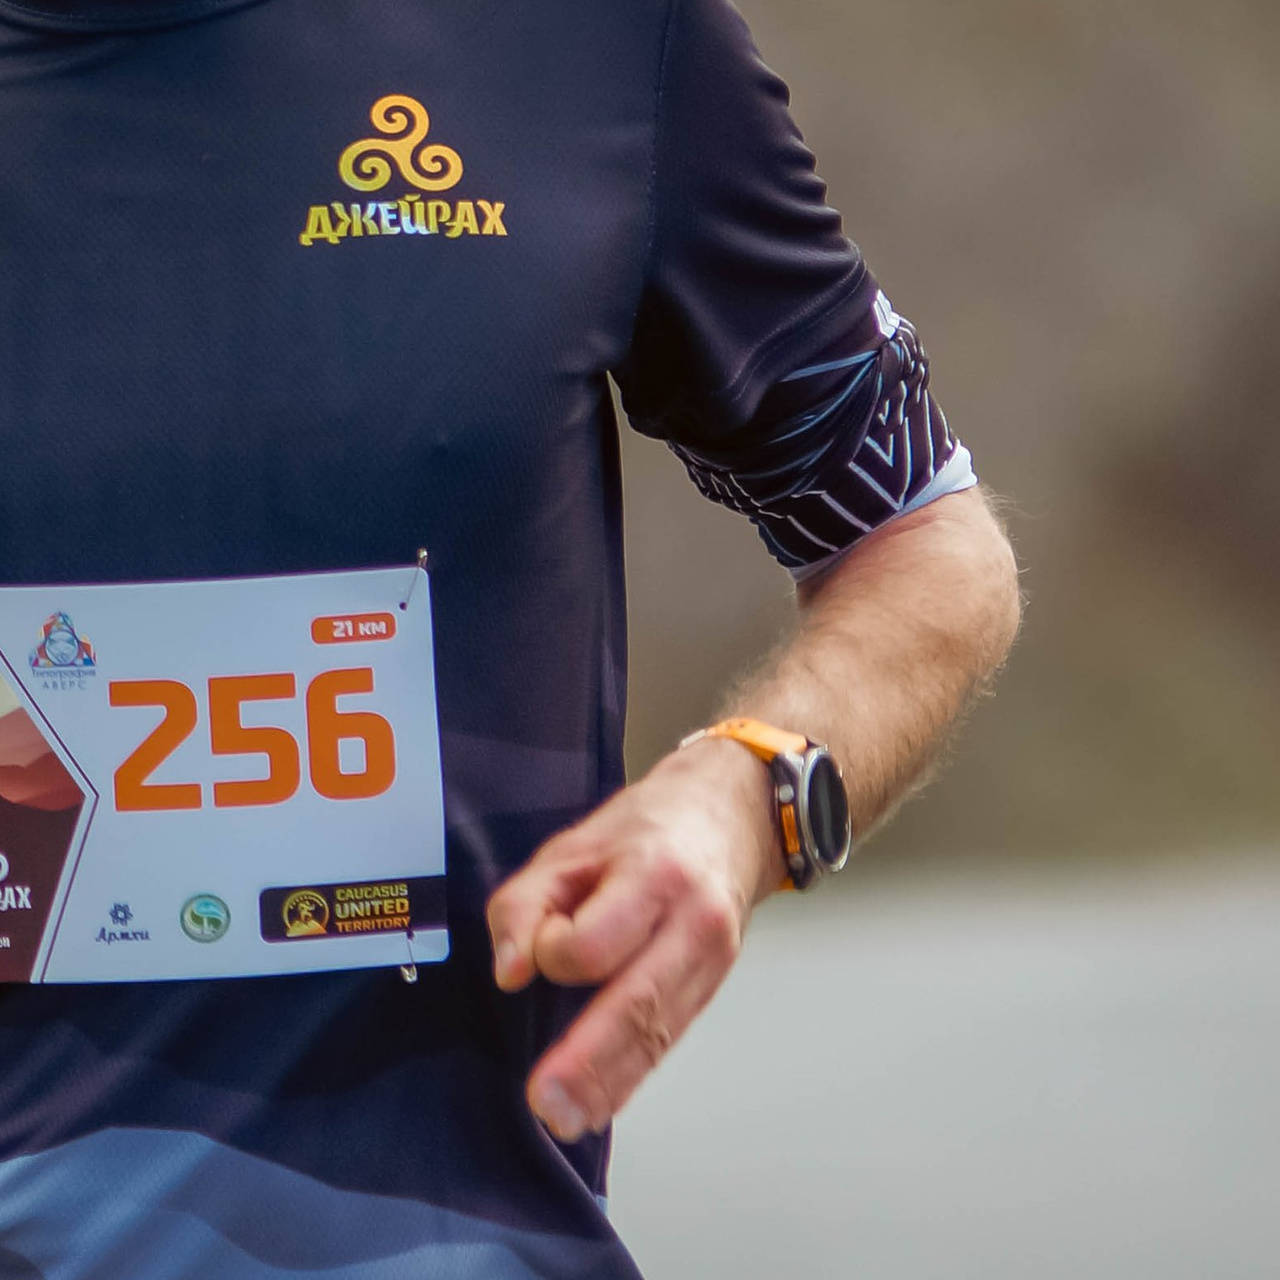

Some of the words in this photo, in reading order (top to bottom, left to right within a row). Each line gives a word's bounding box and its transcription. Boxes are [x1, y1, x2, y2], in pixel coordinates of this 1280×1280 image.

[299, 194, 508, 246] ДЖЕЙРАХ
[332, 620, 353, 638] 21
[109, 667, 396, 812] 256
[335, 884, 409, 901] CAUCASUS
[335, 898, 410, 919] UNITED
[335, 917, 412, 933] TERRITORY
